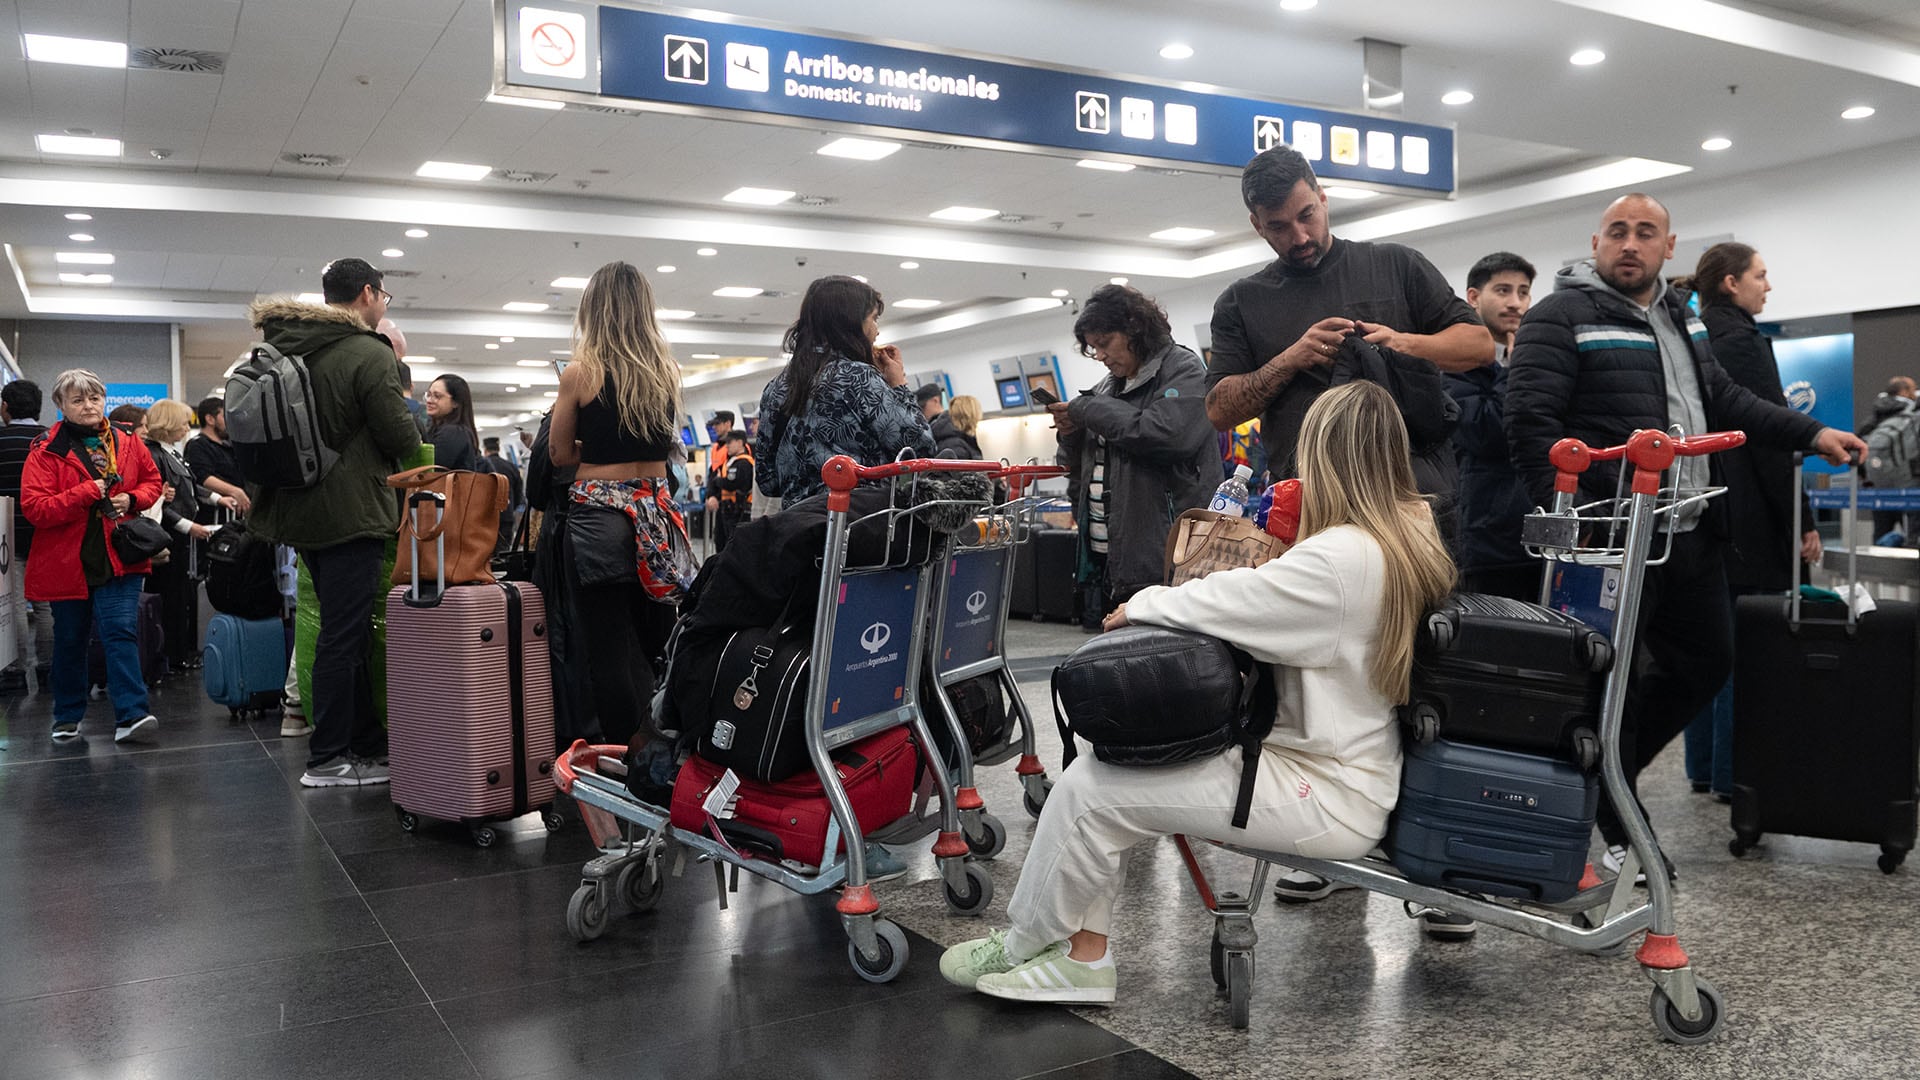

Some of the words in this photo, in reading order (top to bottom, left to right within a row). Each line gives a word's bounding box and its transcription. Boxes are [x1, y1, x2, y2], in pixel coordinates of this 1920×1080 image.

[784, 50, 874, 84] Arribos
[879, 67, 1000, 101] nacionales
[784, 79, 862, 105] Domestic
[865, 92, 922, 113] arrivals
[105, 394, 154, 405] mercado
